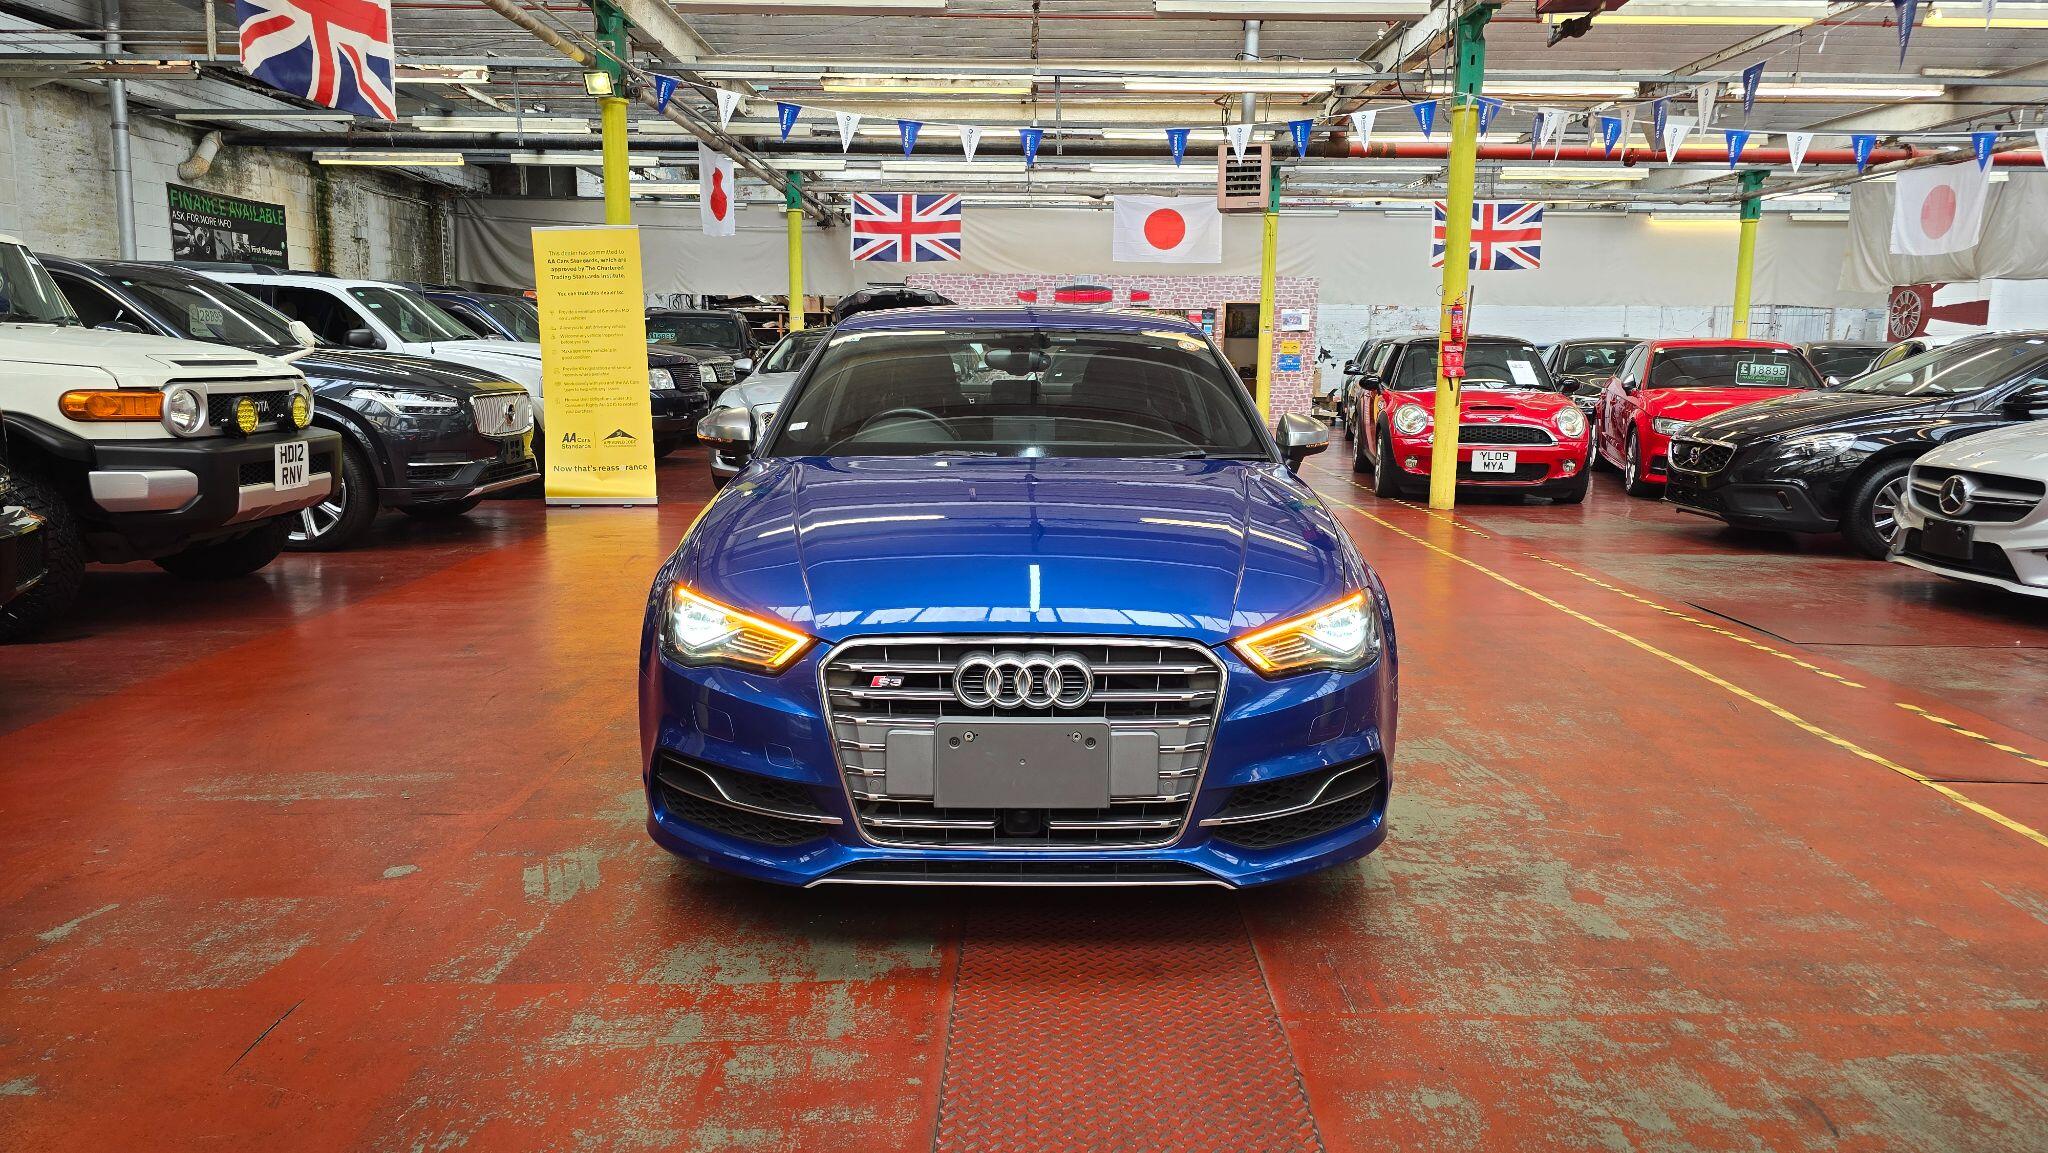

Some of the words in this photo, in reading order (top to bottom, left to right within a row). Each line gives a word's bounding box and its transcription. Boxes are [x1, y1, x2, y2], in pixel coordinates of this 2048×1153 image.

[169, 189, 227, 217] FINANCE
[229, 200, 285, 226] AVAILABLE
[172, 210, 186, 221] ASK
[186, 212, 200, 223] FOR
[217, 217, 232, 229] INFO
[251, 245, 261, 254] First
[561, 432, 576, 443] AA
[280, 444, 304, 464] HD12
[1480, 451, 1509, 461] YL09
[573, 464, 597, 472] that's
[598, 464, 648, 472] reassrance
[1483, 461, 1504, 471] MYA
[282, 465, 303, 485] RNV
[878, 676, 902, 687] S3
